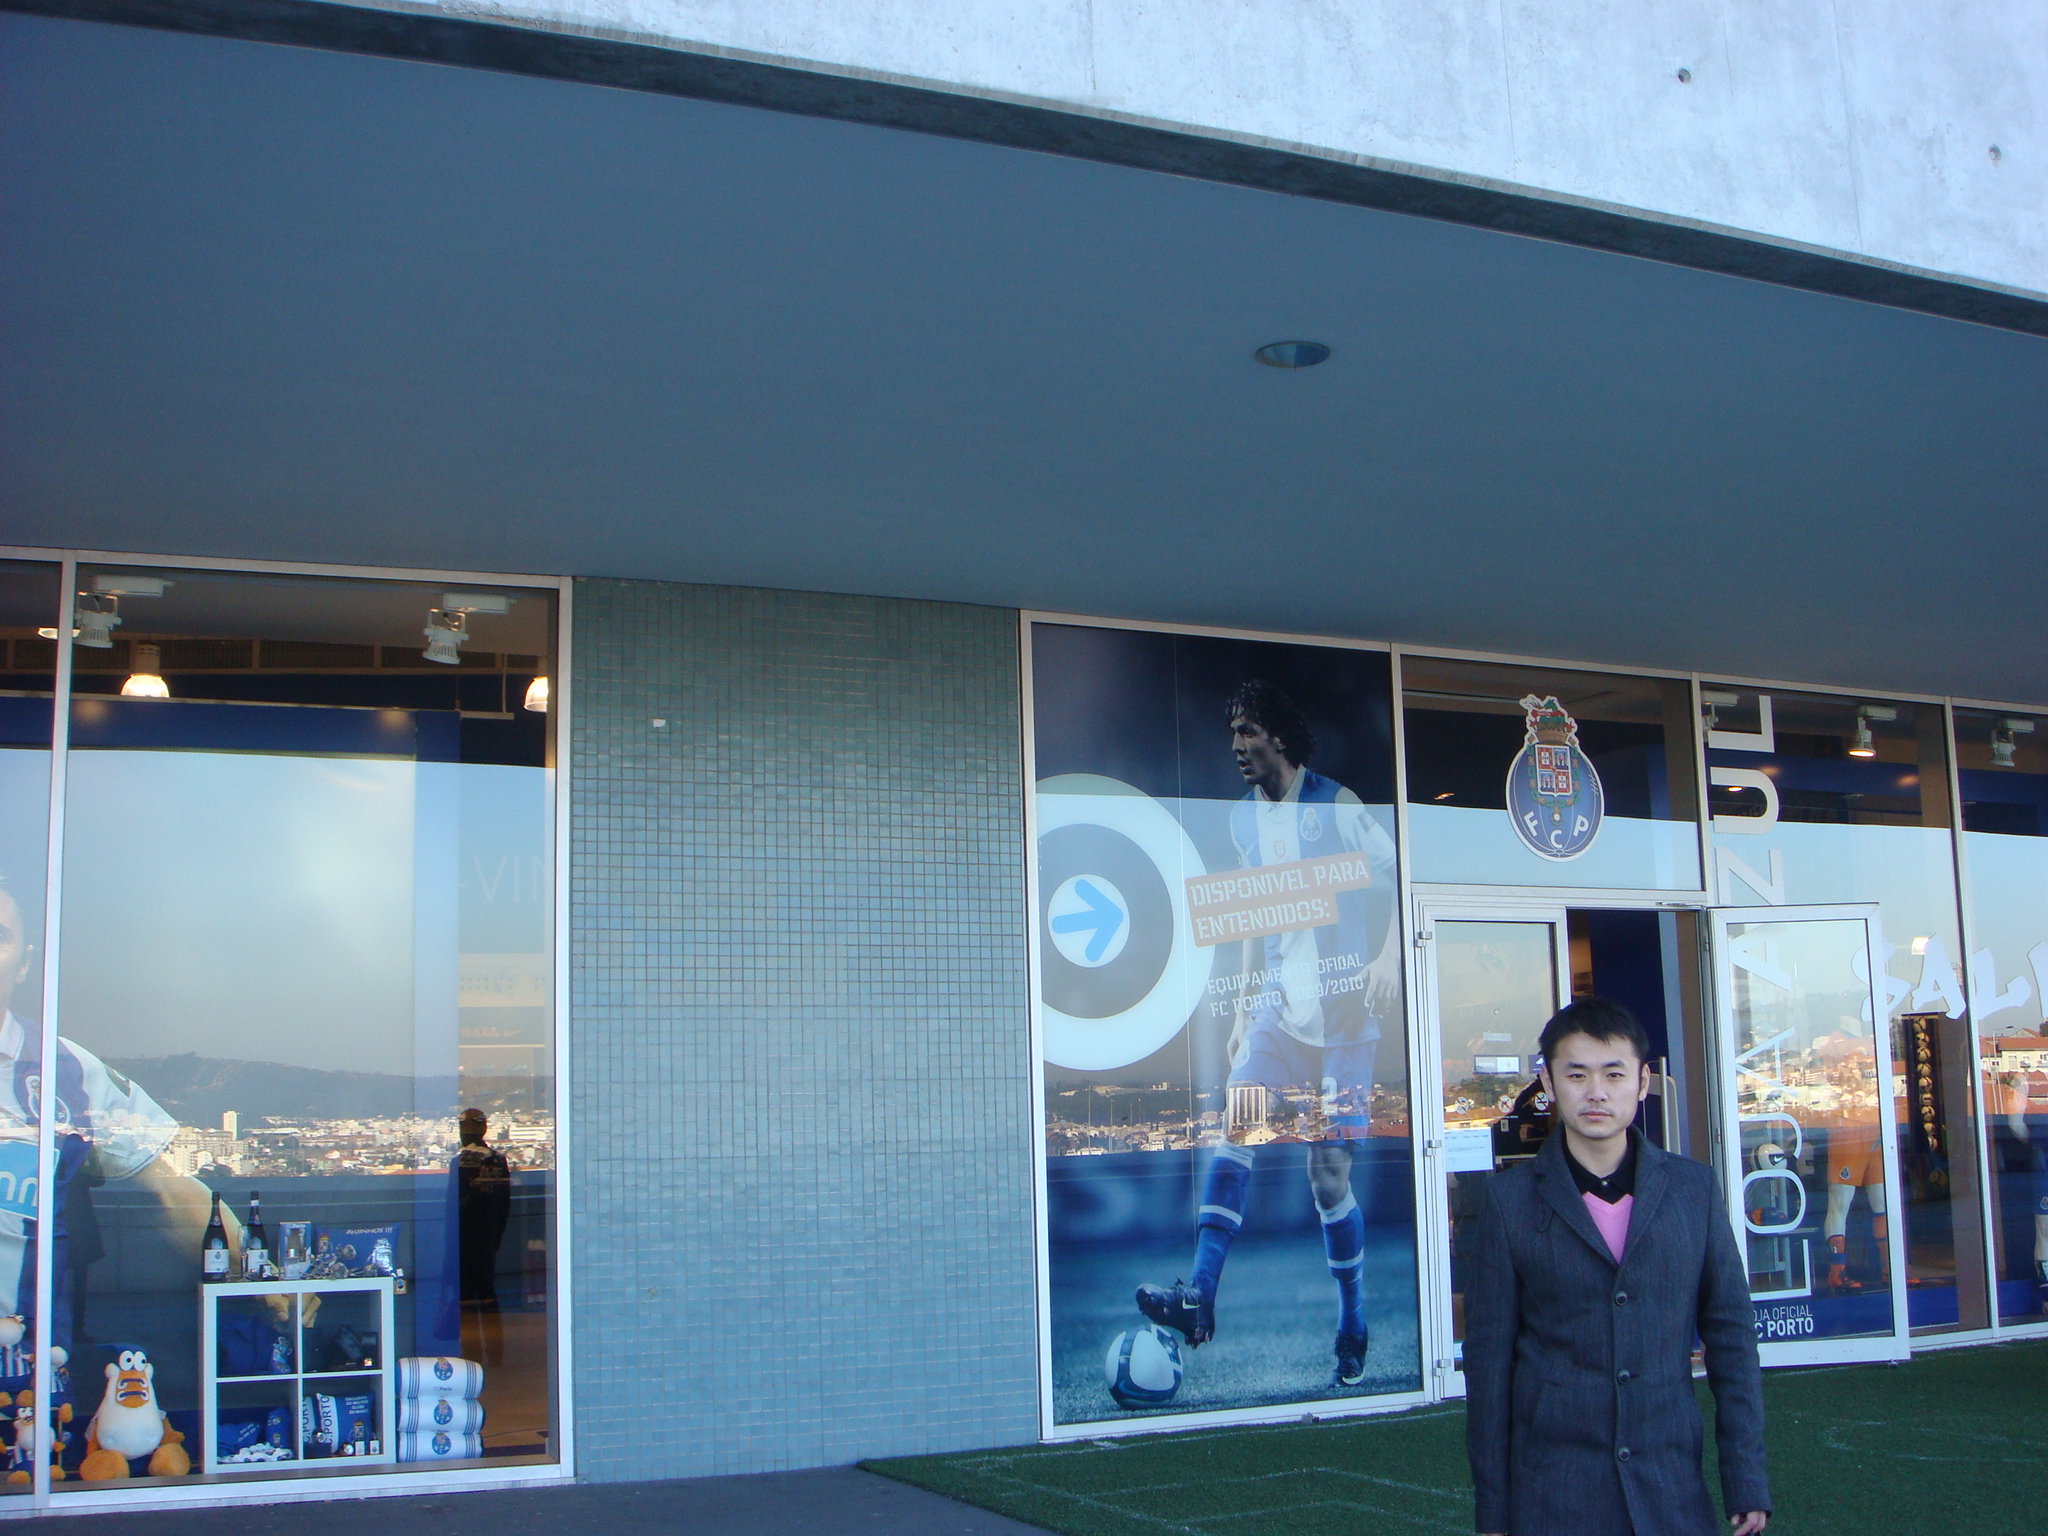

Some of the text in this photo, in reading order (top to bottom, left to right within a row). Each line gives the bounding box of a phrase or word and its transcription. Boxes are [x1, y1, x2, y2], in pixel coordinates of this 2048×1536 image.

[1708, 695, 1791, 991] AZUL
[1189, 859, 1369, 906] DISPONIVEL PARA
[1196, 898, 1330, 939] ENTENDIDOS:
[1207, 962, 1309, 995] EQUIPAMENTO
[1210, 1001, 1228, 1017] FC
[1233, 990, 1282, 1013] PORTO
[1735, 1026, 1811, 1301] LOJA
[1767, 1317, 1814, 1338] PORTO
[1772, 1304, 1813, 1320] OFICIAL
